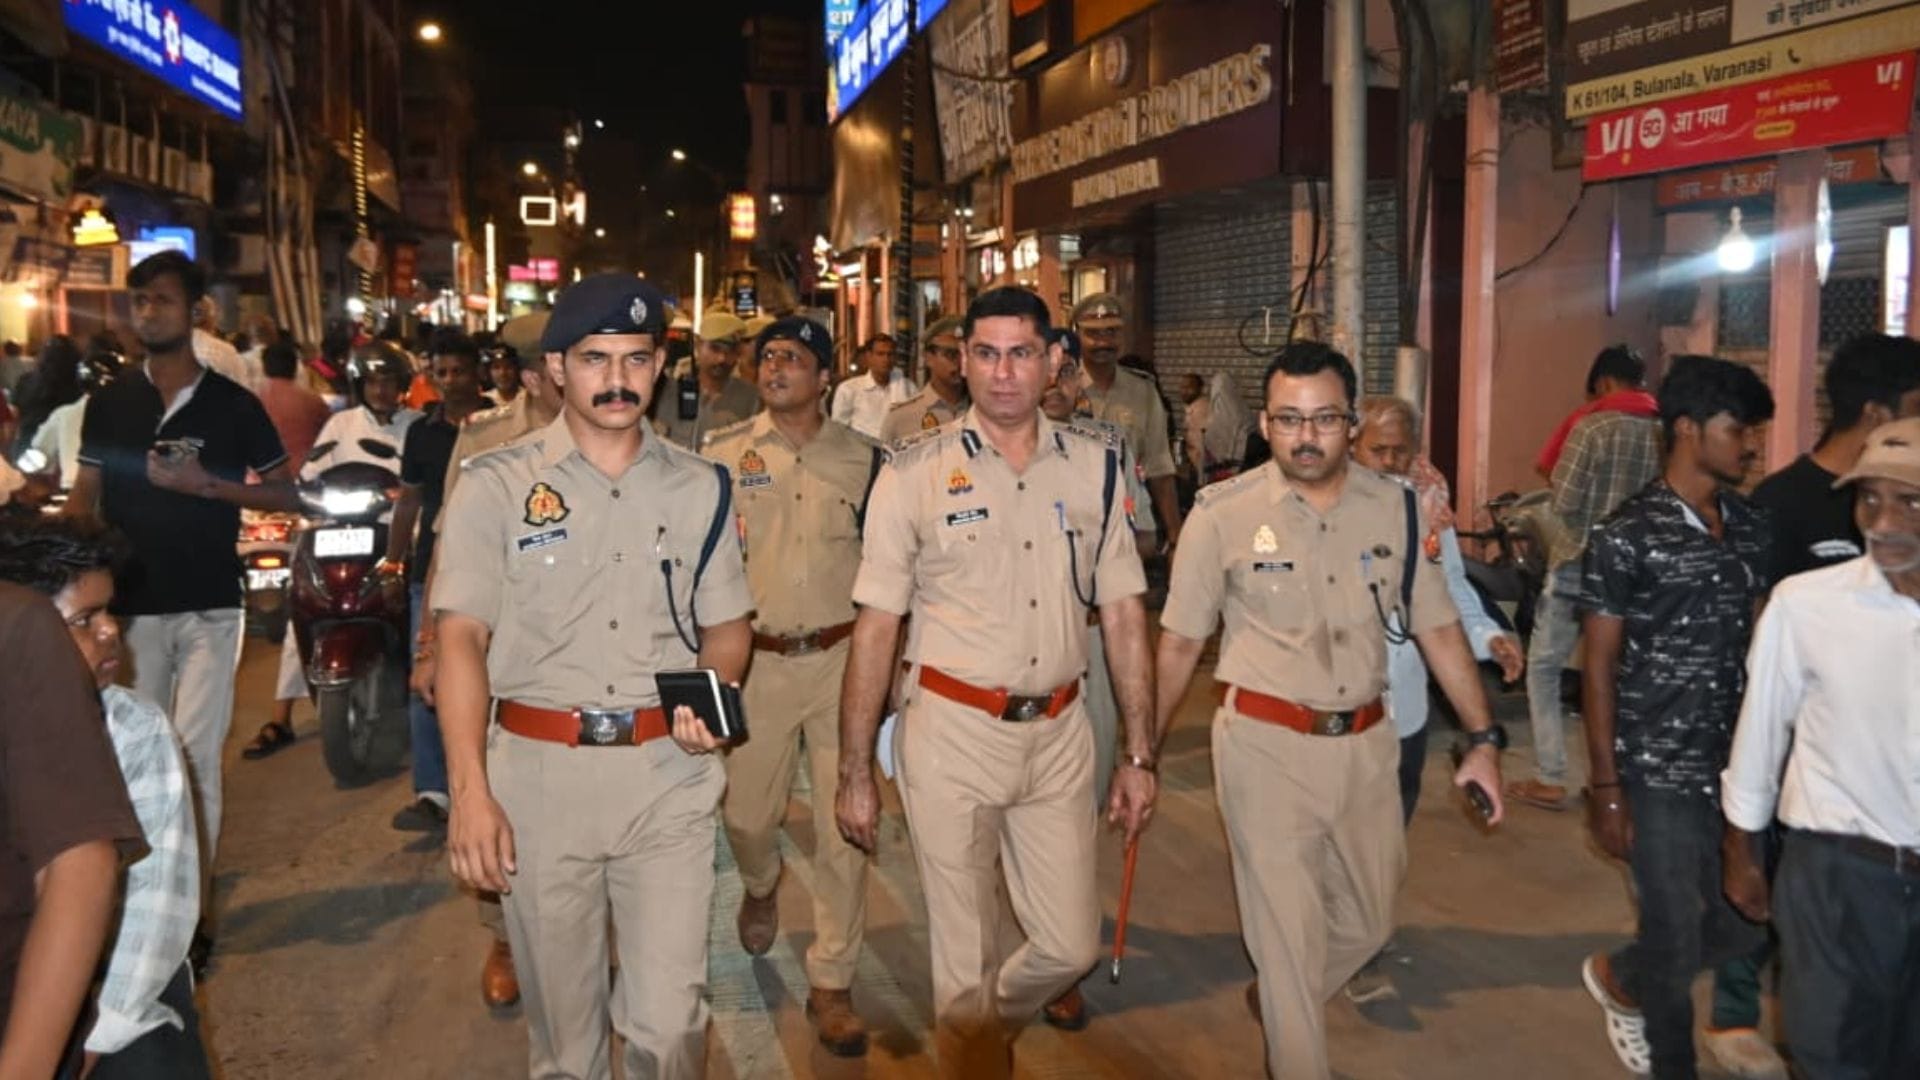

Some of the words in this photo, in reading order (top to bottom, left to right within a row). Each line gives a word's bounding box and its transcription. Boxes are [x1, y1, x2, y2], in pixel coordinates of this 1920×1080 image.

[1137, 43, 1272, 142] BROTHERS
[1572, 93, 1584, 110] K
[1585, 83, 1629, 106] 61/104,
[1633, 70, 1699, 98] Bulanala,
[1703, 51, 1772, 84] Varanasi
[1642, 117, 1662, 138] 5G
[1671, 110, 1695, 134] आ
[1698, 103, 1730, 129] गया
